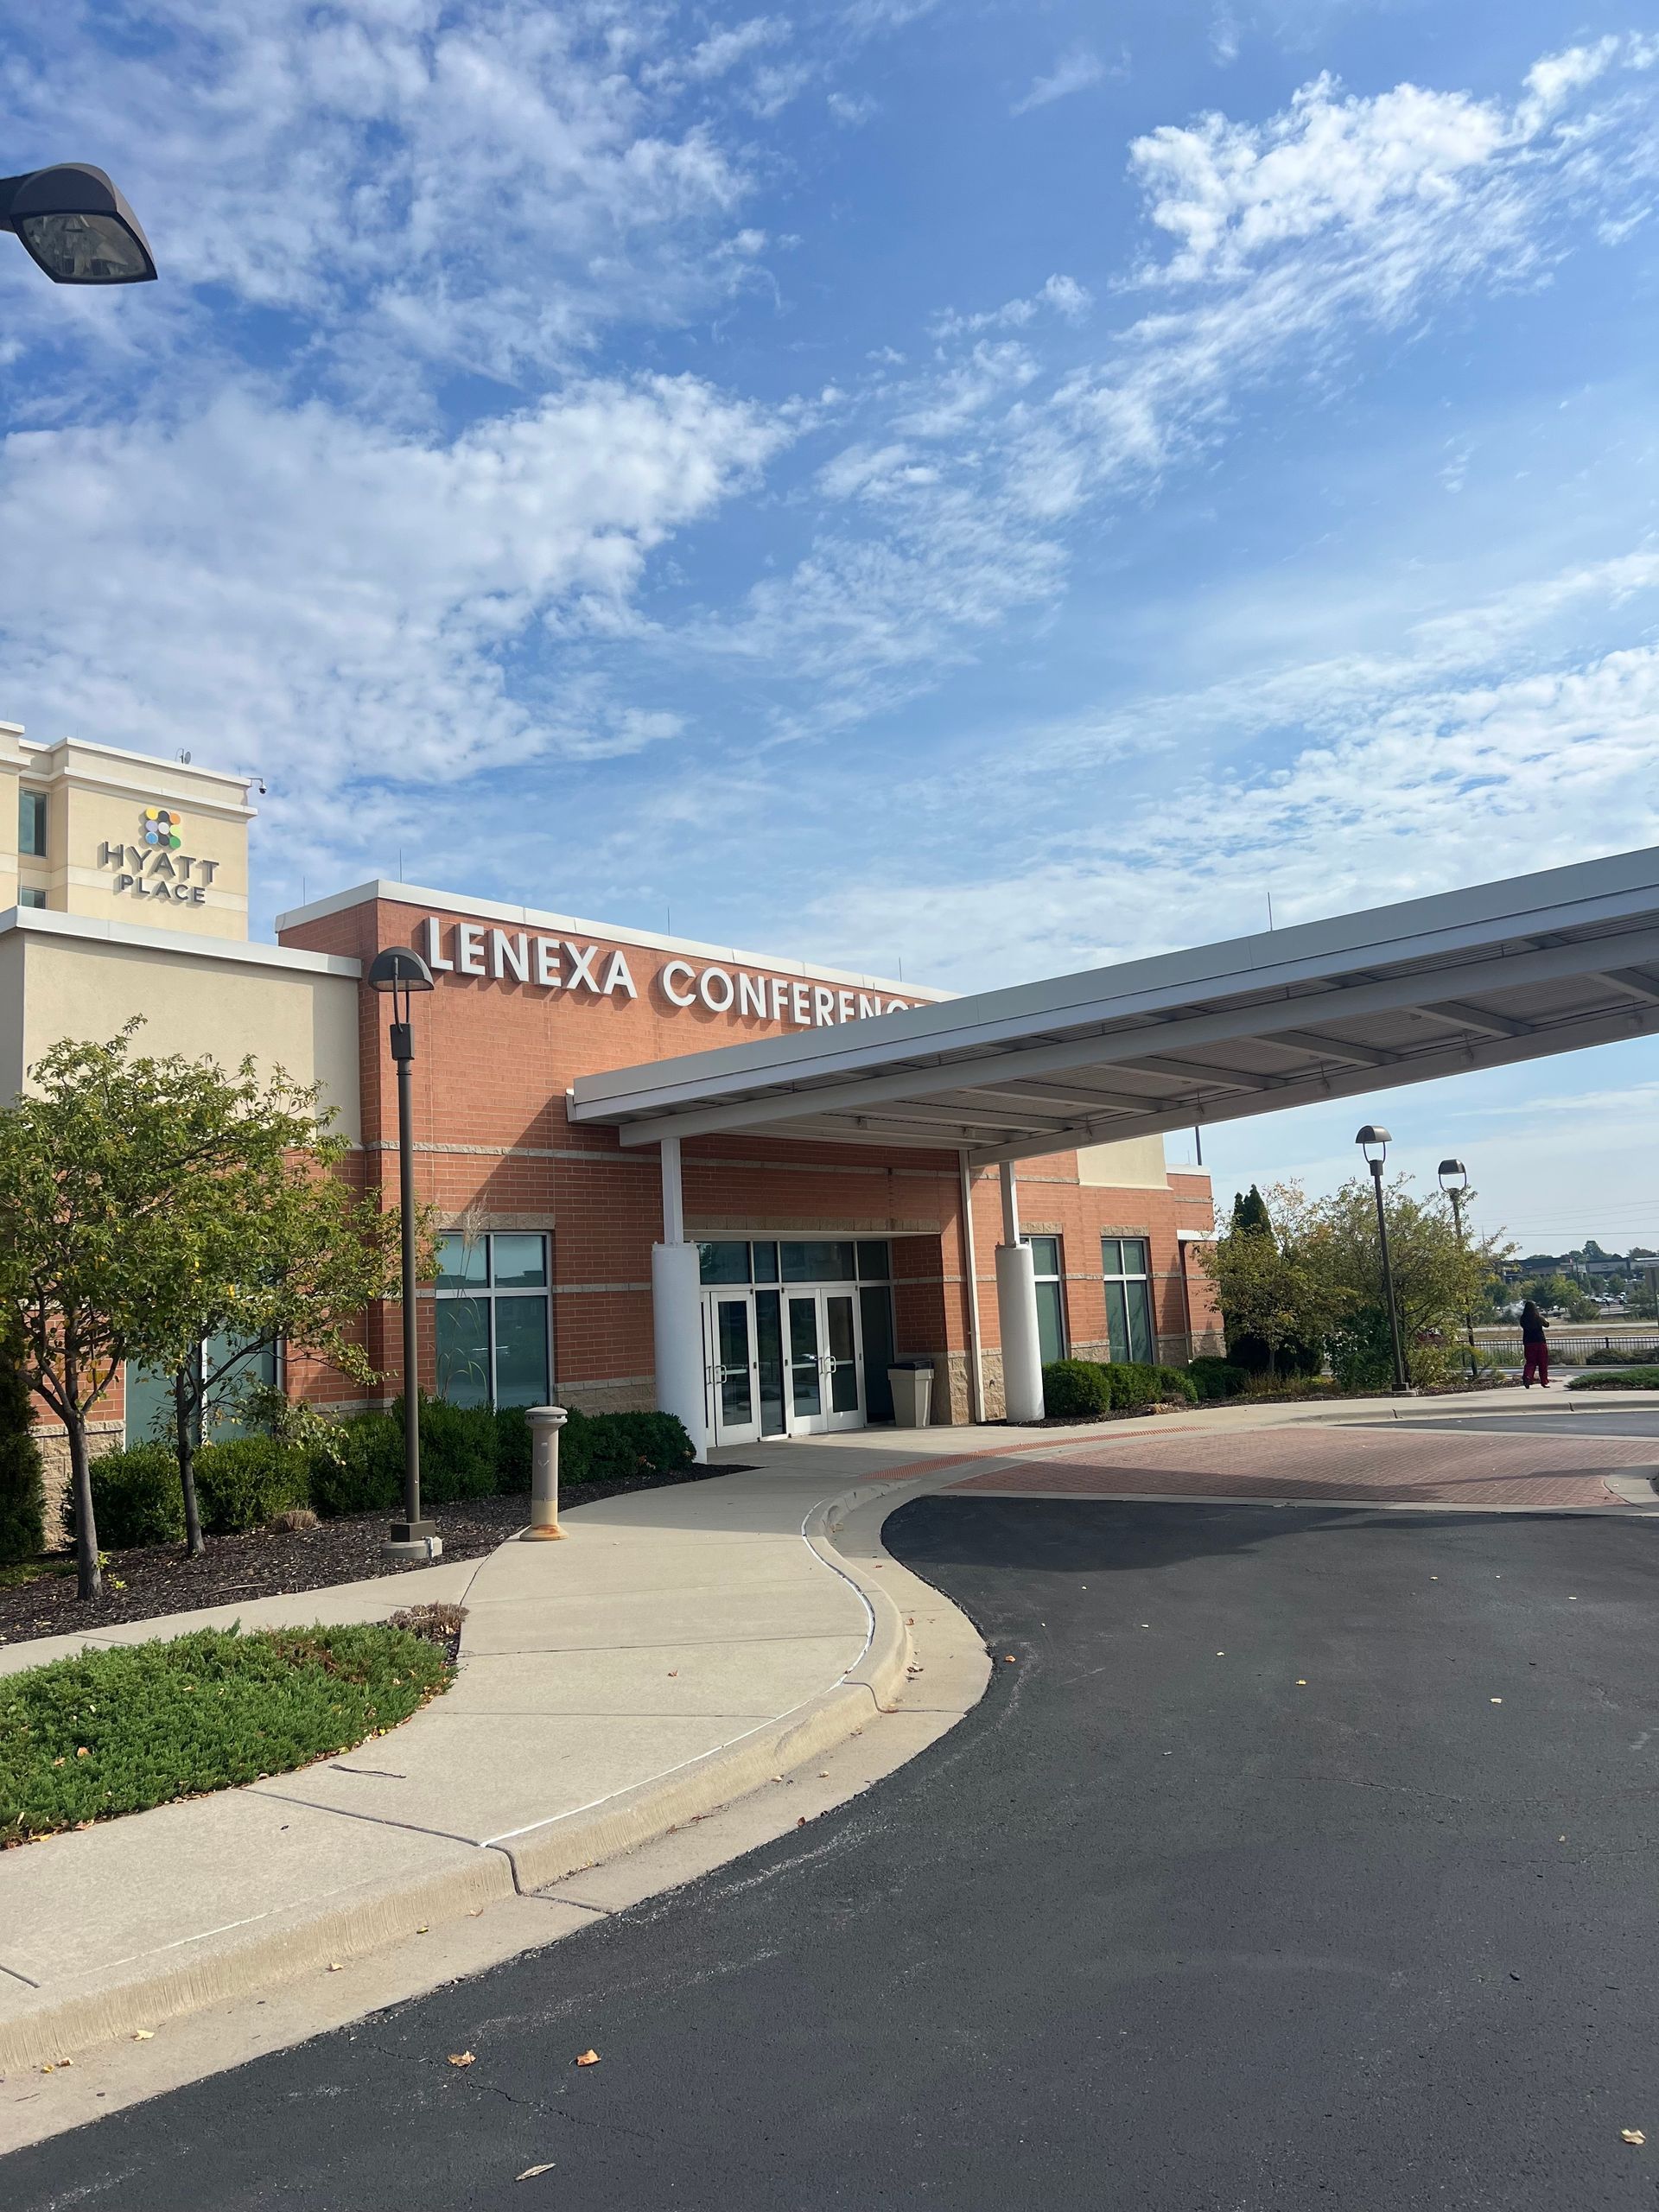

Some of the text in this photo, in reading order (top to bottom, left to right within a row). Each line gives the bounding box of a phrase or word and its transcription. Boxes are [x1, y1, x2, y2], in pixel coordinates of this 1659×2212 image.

[103, 841, 219, 884] HYATT
[120, 874, 206, 904] PLACE
[425, 916, 927, 1027] LENEXA CONFEREN
